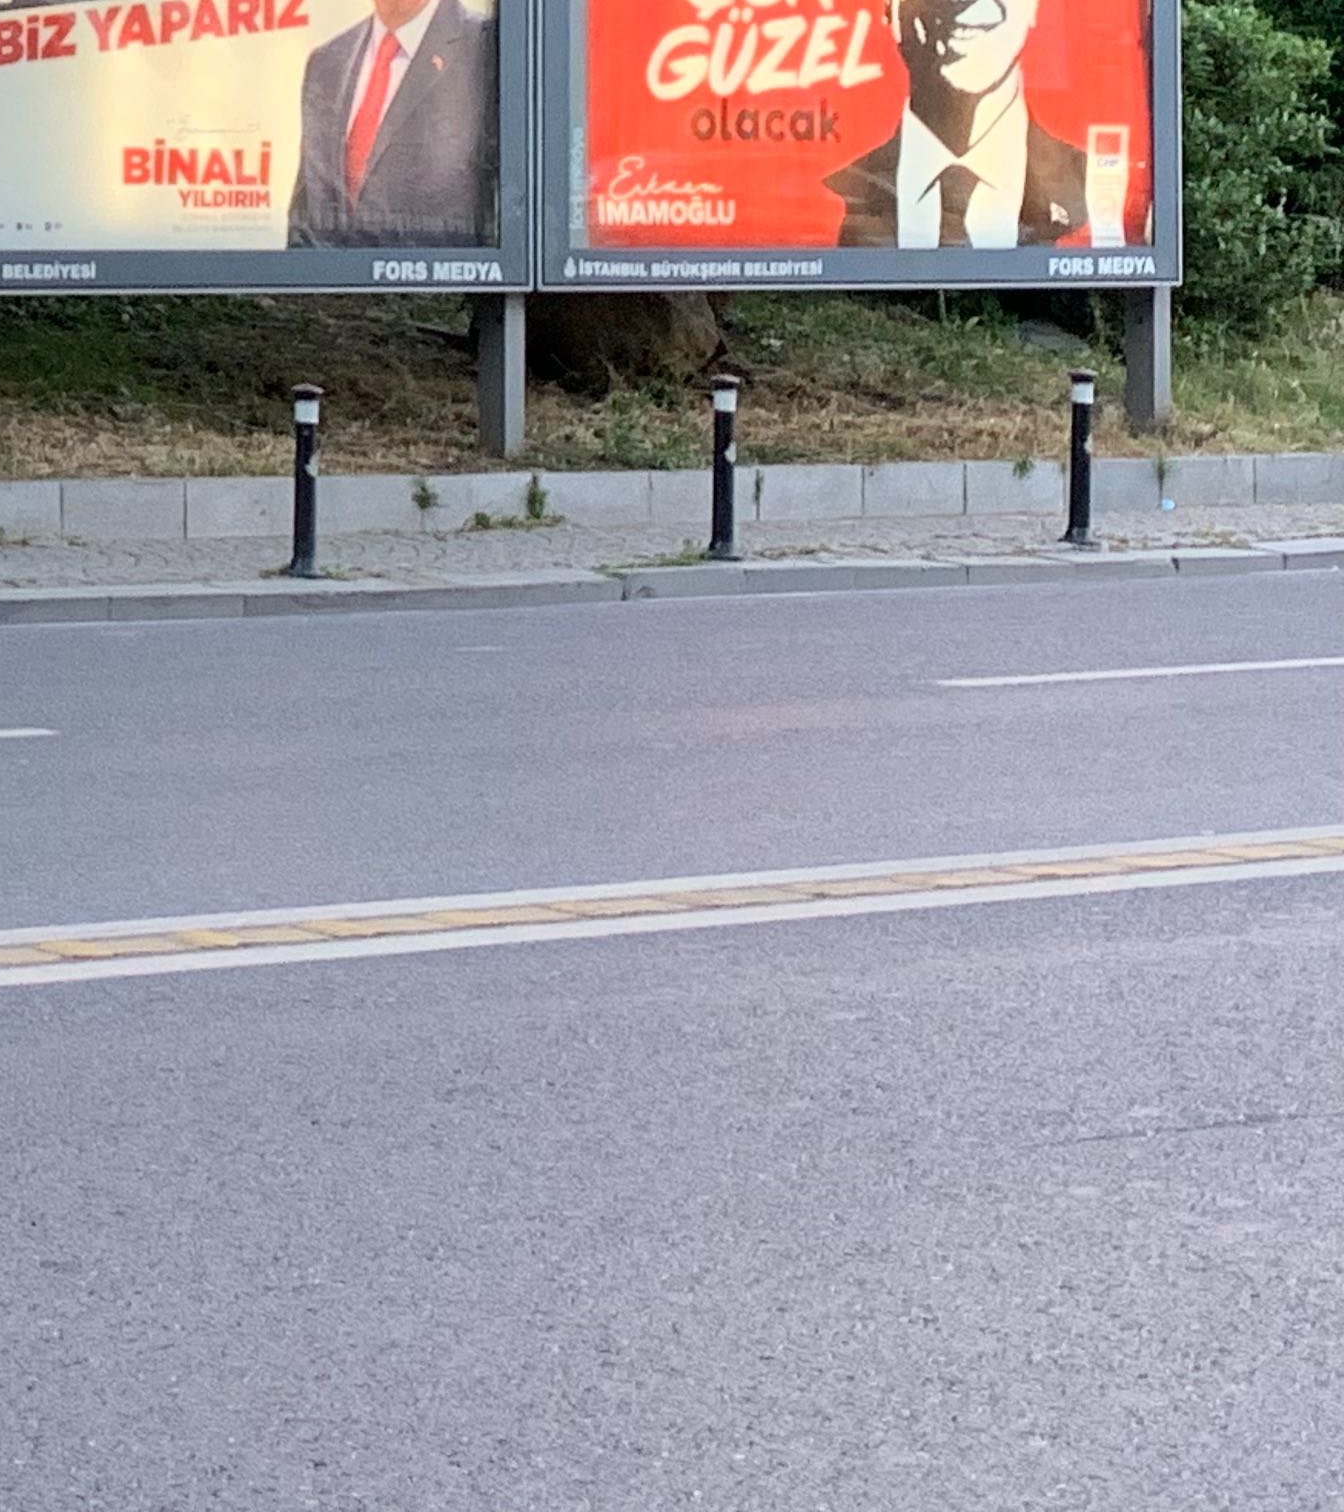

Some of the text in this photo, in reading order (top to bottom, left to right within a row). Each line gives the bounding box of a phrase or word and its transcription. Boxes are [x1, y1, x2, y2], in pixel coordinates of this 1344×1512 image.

[646, 6, 885, 101] GÜZEL
[690, 97, 843, 144] olacak
[122, 138, 272, 186] BİNALİ
[178, 189, 272, 209] YILDIRIM
[597, 196, 736, 226] İMAMOĞLU
[2, 260, 97, 280] BELEDİYESİ
[372, 260, 504, 281] FORS MEDYA
[1048, 255, 1156, 276] FORS MEDYA
